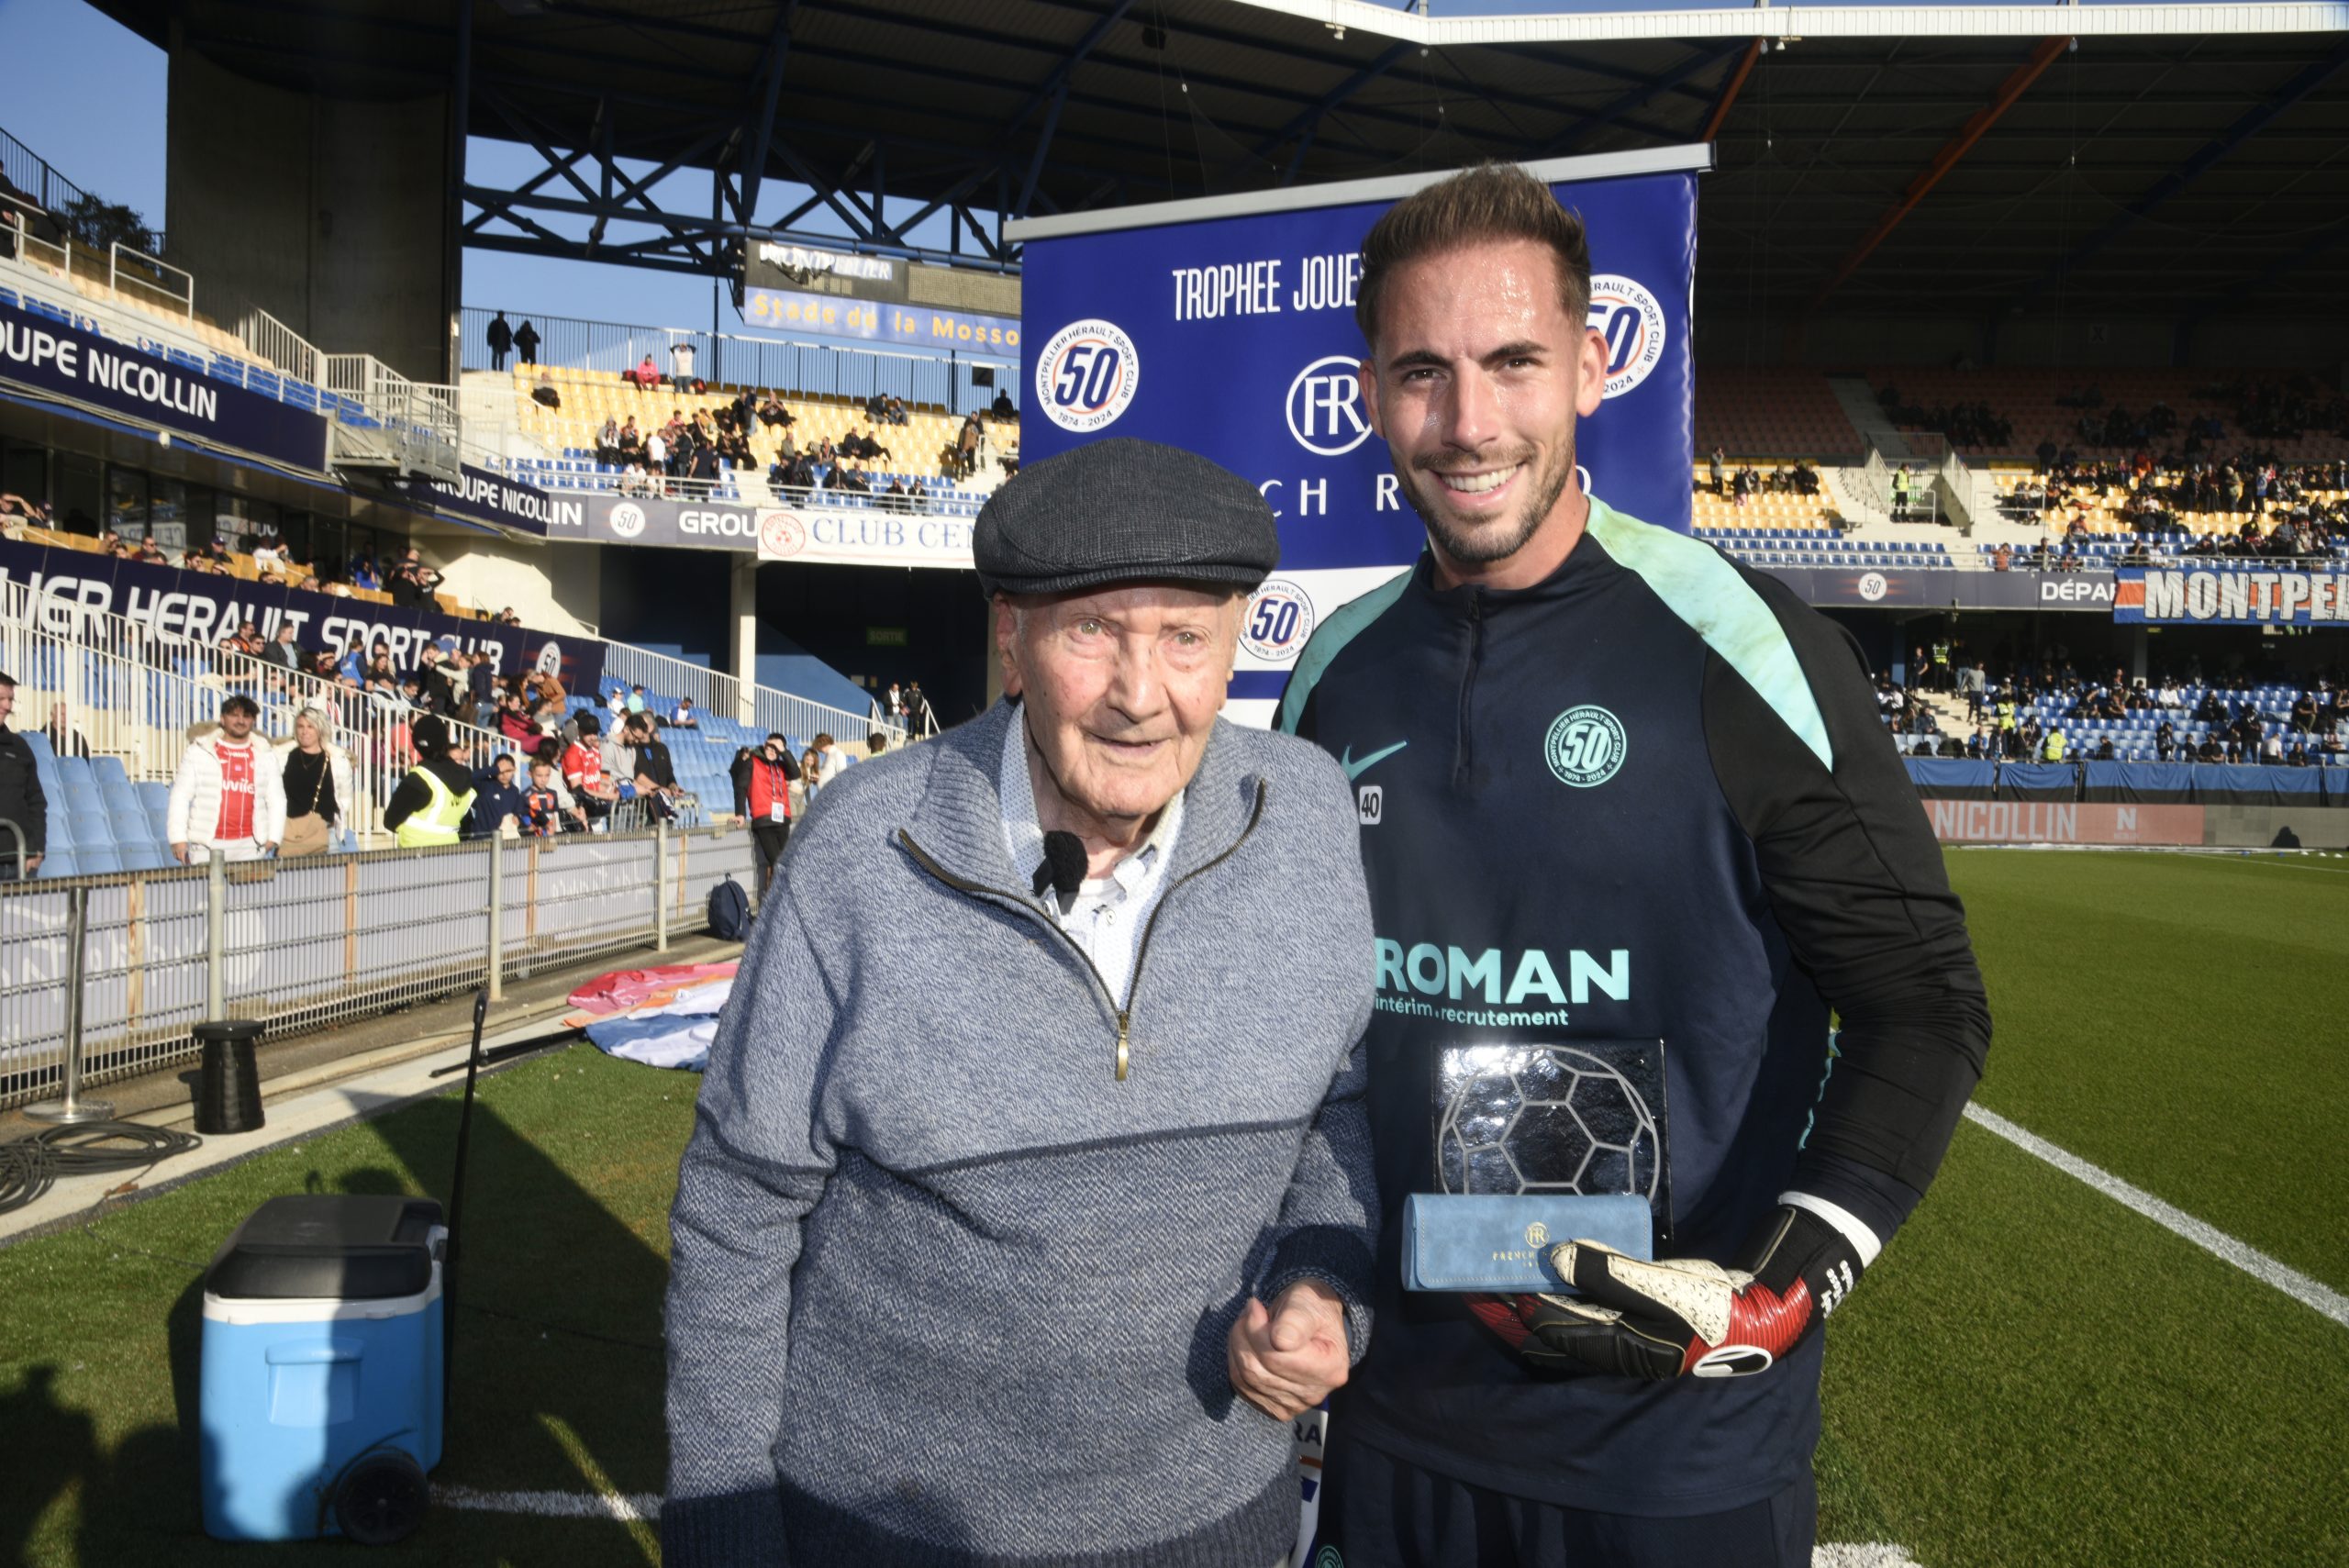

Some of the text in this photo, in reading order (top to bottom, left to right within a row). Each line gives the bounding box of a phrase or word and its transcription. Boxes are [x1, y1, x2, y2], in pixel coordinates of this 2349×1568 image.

[1173, 252, 1365, 321] TROPHEE JOUE
[754, 295, 835, 324] Stade
[848, 307, 877, 330] de
[896, 311, 916, 334] la
[1041, 325, 1134, 406] MONTPELLIER HÉRAULT SPORT CLUB
[1644, 331, 1660, 362] CLUB
[88, 348, 217, 422] NICOLLIN
[1054, 346, 1119, 410] 50
[1058, 410, 1113, 427] 1974 2024
[502, 487, 583, 525] NICOLLIN
[618, 510, 637, 529] 50
[813, 517, 905, 547] CLUB
[1865, 579, 1881, 595] 50
[1251, 598, 1299, 645] 50
[322, 616, 431, 672] SPORT
[1549, 717, 1570, 768] MONTPELLIER
[1603, 717, 1621, 740] SPORT
[1561, 725, 1609, 771] 50
[1610, 741, 1621, 762] CLUB
[1586, 769, 1607, 782] 2024
[1361, 793, 1380, 818] 40
[1934, 800, 2076, 841] NICOLLIN
[2116, 807, 2137, 830] N
[1375, 937, 1630, 1005] ROMAN
